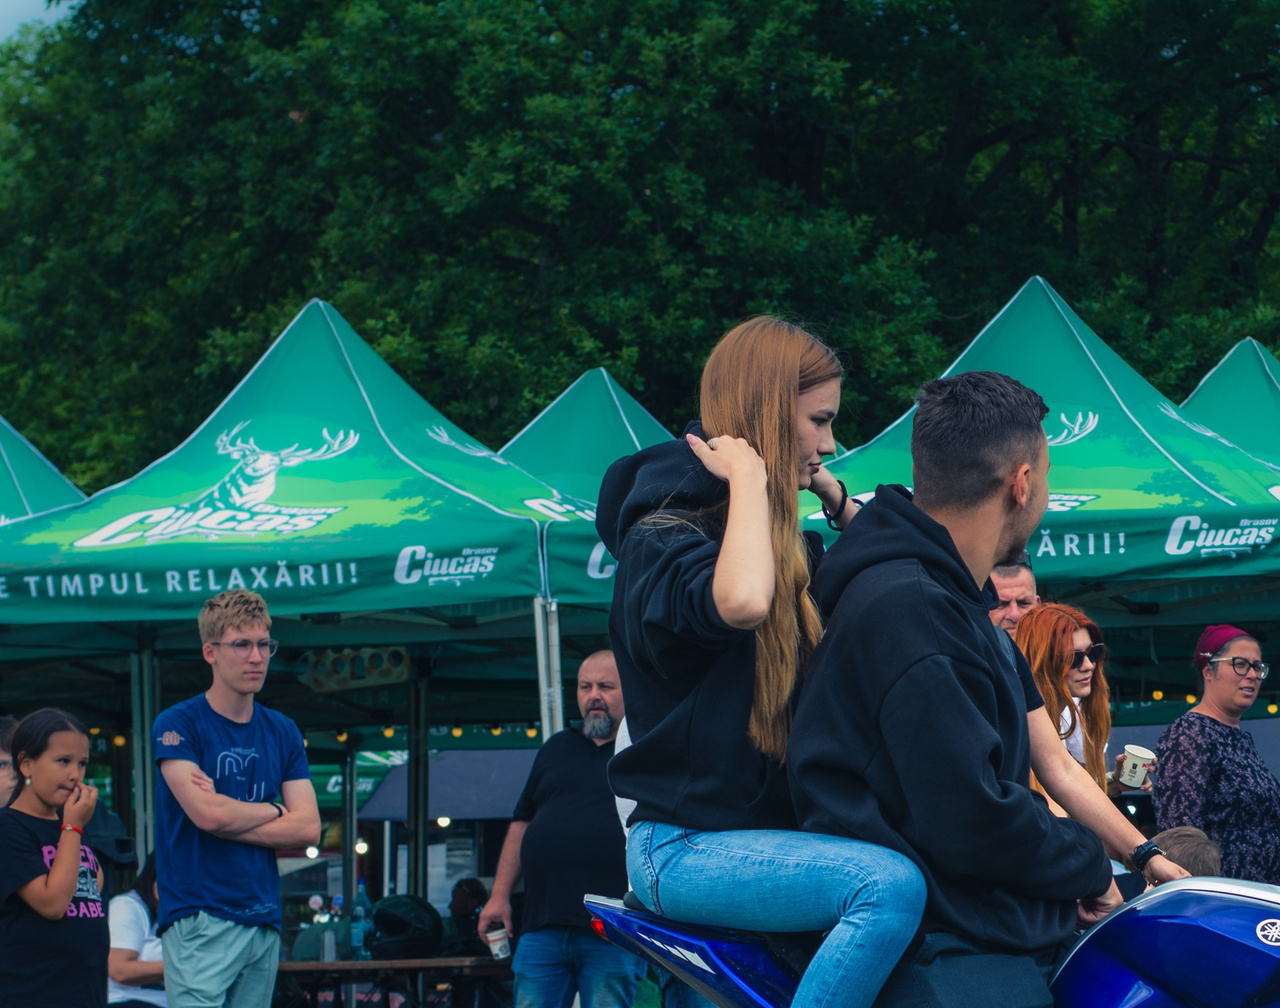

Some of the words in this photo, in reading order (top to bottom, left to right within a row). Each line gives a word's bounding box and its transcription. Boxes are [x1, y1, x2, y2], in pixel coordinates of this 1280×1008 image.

[23, 571, 149, 598] TIMPUL
[165, 560, 359, 592] RELAXĂRII!
[66, 901, 105, 918] BABE
